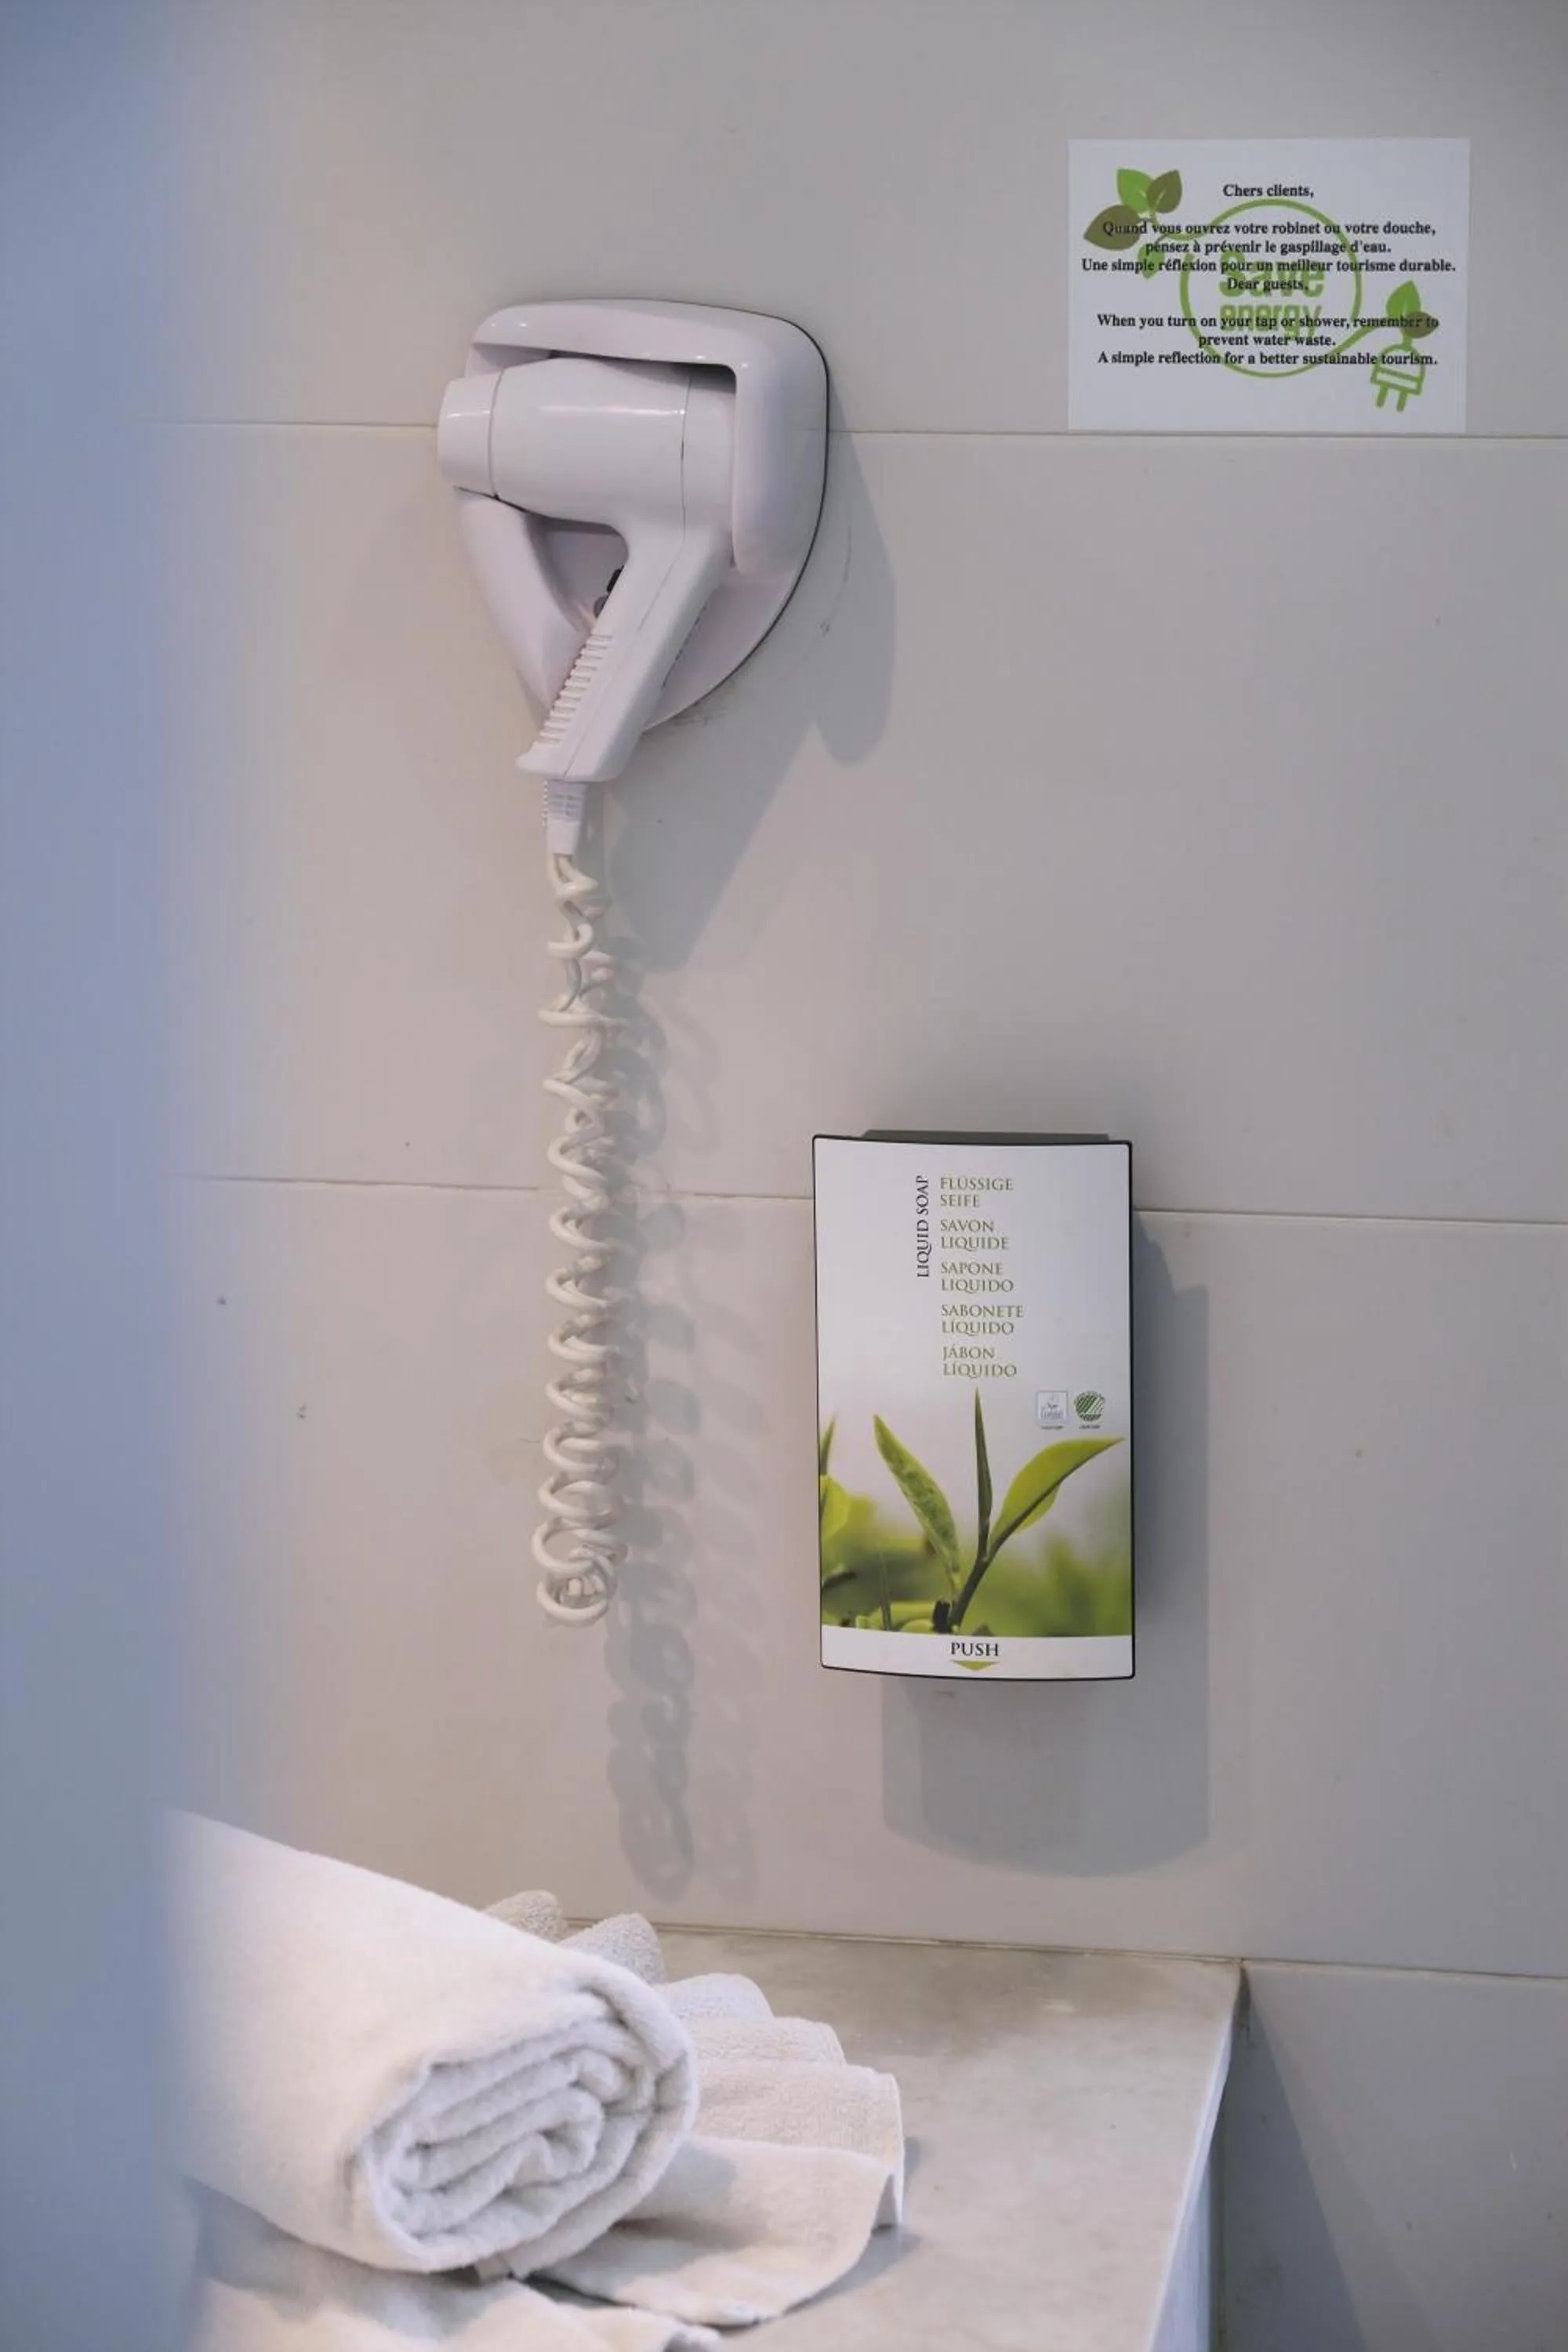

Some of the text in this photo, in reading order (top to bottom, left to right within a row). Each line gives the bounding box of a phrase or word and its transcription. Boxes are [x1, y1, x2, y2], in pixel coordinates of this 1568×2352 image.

[1223, 183, 1314, 198] Chers clients,
[1102, 221, 1436, 235] Quand vous ouvrez votre robinet ou votre douche,
[1145, 240, 1391, 256] pensez à prévenir le gaspillage d'eau.
[1082, 258, 1456, 274] Une simple réflexion pour un meilleur tourisme durable.
[1219, 250, 1325, 297] Save
[1227, 278, 1259, 289] Dear
[1097, 314, 1439, 329] When you turn on your tap or shower, remember to
[1220, 304, 1322, 340] energy
[1198, 335, 1336, 347] prevent water waste.
[1098, 351, 1437, 366] A simple reflection for a better sustainable tourism.
[941, 1194, 980, 1207] SEIFE
[916, 1175, 932, 1278] LIQUID SOAP
[941, 1219, 994, 1232] SAVON
[941, 1236, 1009, 1251] LIQUIDE
[941, 1261, 1004, 1275] SAPONE
[942, 1279, 1014, 1294] LIQUIDO
[941, 1304, 1024, 1318] SABONETE
[950, 1642, 999, 1657] PUSH
